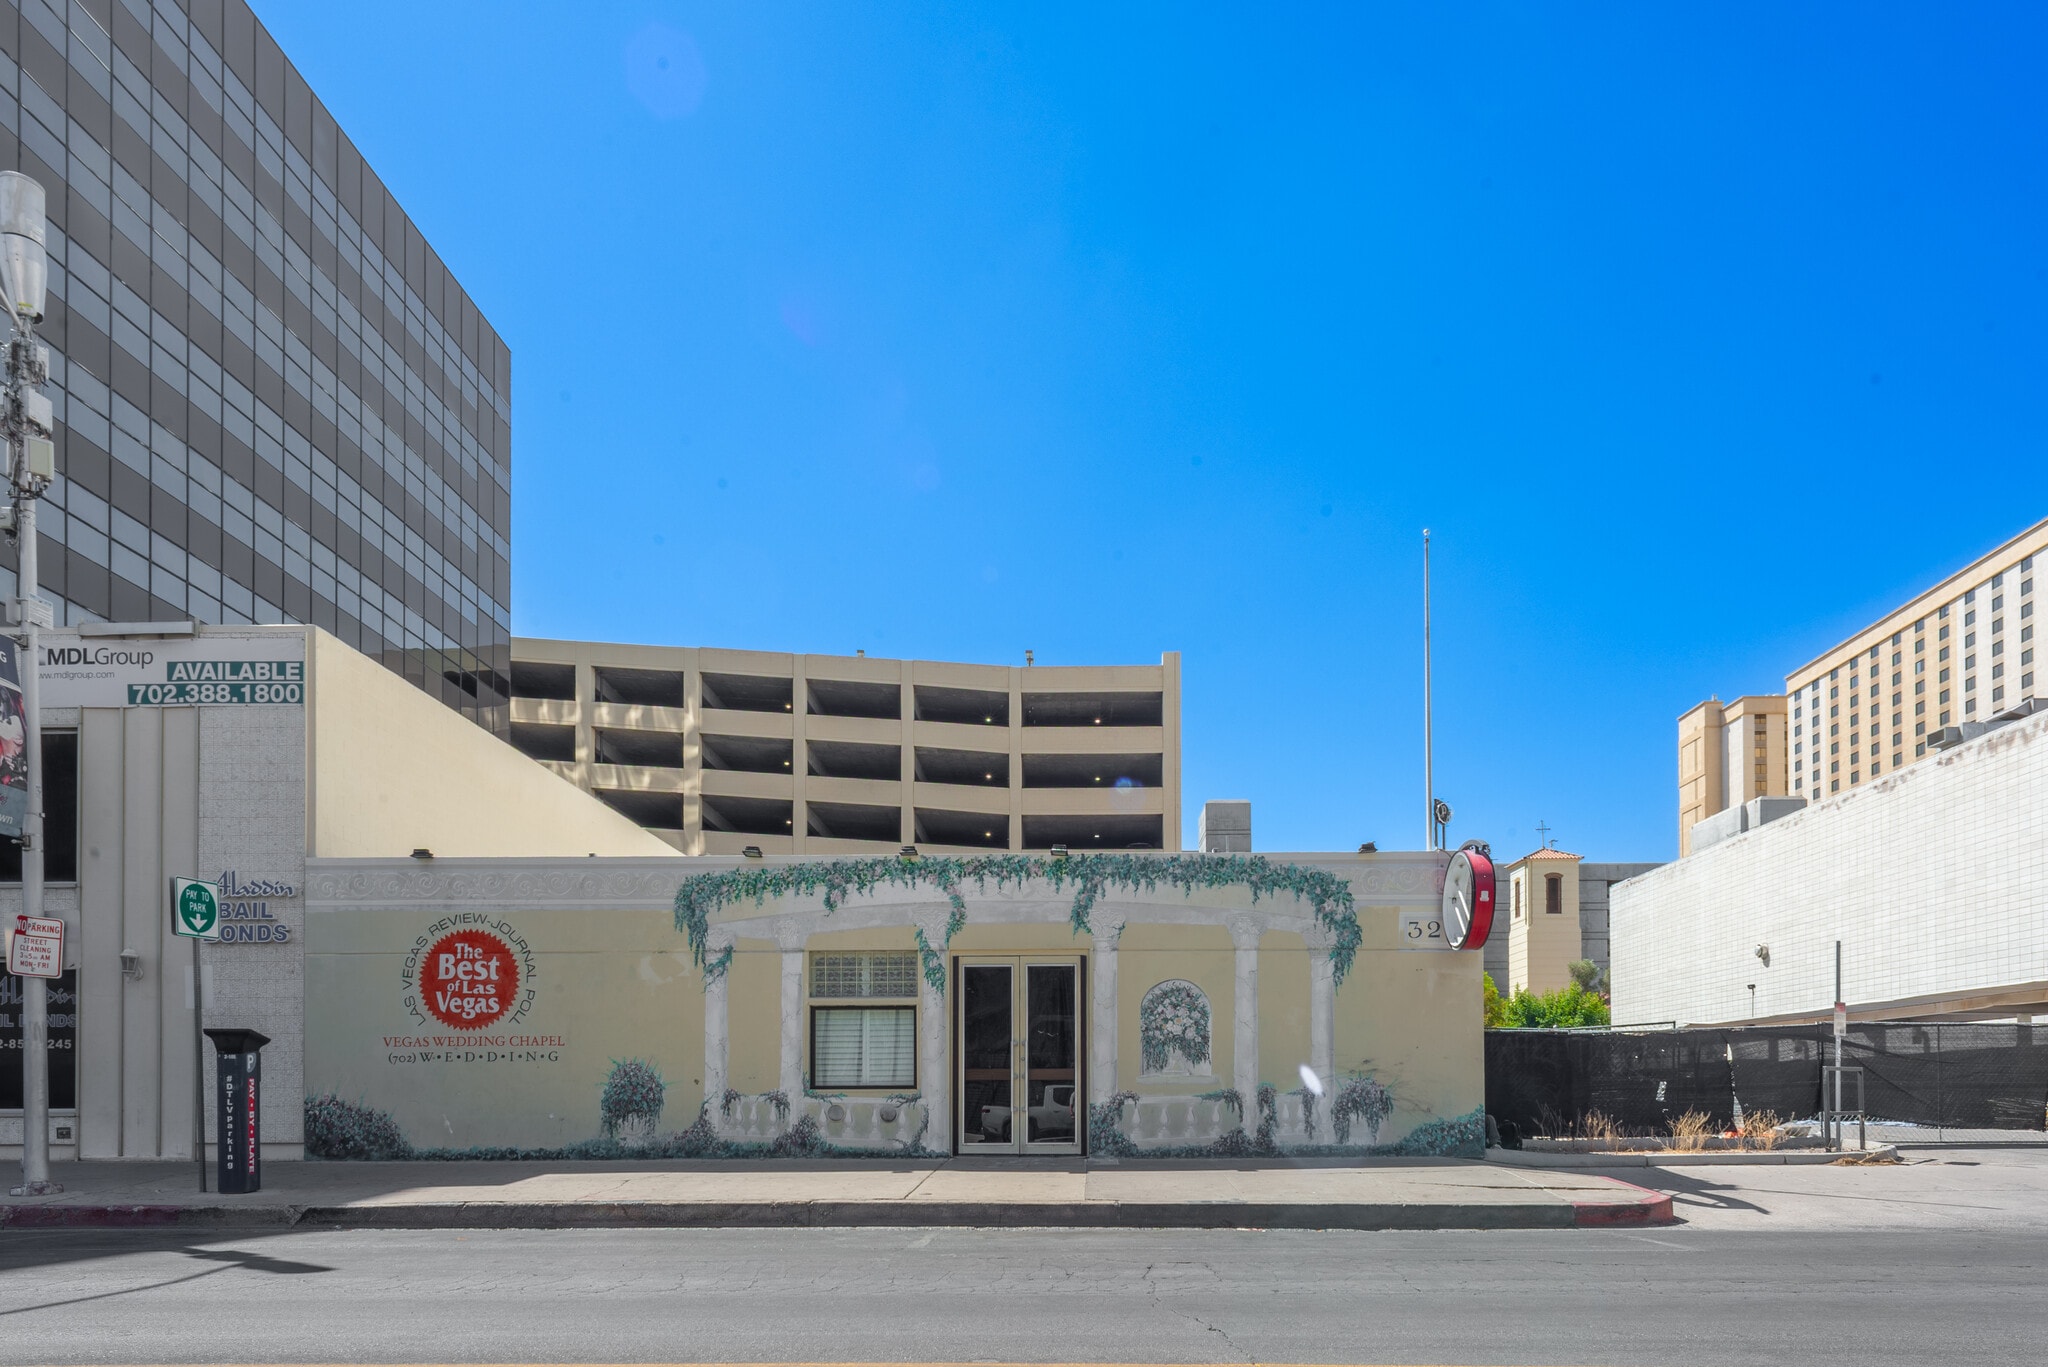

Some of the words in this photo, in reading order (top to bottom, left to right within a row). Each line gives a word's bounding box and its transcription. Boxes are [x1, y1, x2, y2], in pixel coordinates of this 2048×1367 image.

[47, 648, 154, 669] MDLGroup
[171, 662, 300, 681] AVAILABLE
[132, 684, 300, 703] 702.388.1800
[217, 870, 294, 896] Aladdin
[185, 889, 197, 900] PAY
[201, 891, 210, 902] TO
[189, 901, 207, 913] PARK
[219, 902, 273, 919] BAIL
[27, 922, 60, 934] PARKING
[204, 924, 288, 942] ONDS
[19, 944, 52, 953] CLEANING
[23, 937, 47, 945] STREET
[428, 912, 537, 983] REVIEW-JOURNAL
[454, 943, 483, 960] The
[20, 960, 49, 968] MON-FRI
[402, 935, 428, 991] VEGAS
[437, 953, 500, 981] Best
[447, 980, 461, 993] of
[462, 981, 496, 995] Las
[404, 995, 426, 1026] LAS
[436, 991, 500, 1019] Vegas
[508, 989, 536, 1024] POLL
[383, 1036, 430, 1048] VEGAS
[432, 1036, 506, 1047] WEDDING
[509, 1035, 565, 1047] CHAPEL
[388, 1052, 417, 1065] (702)
